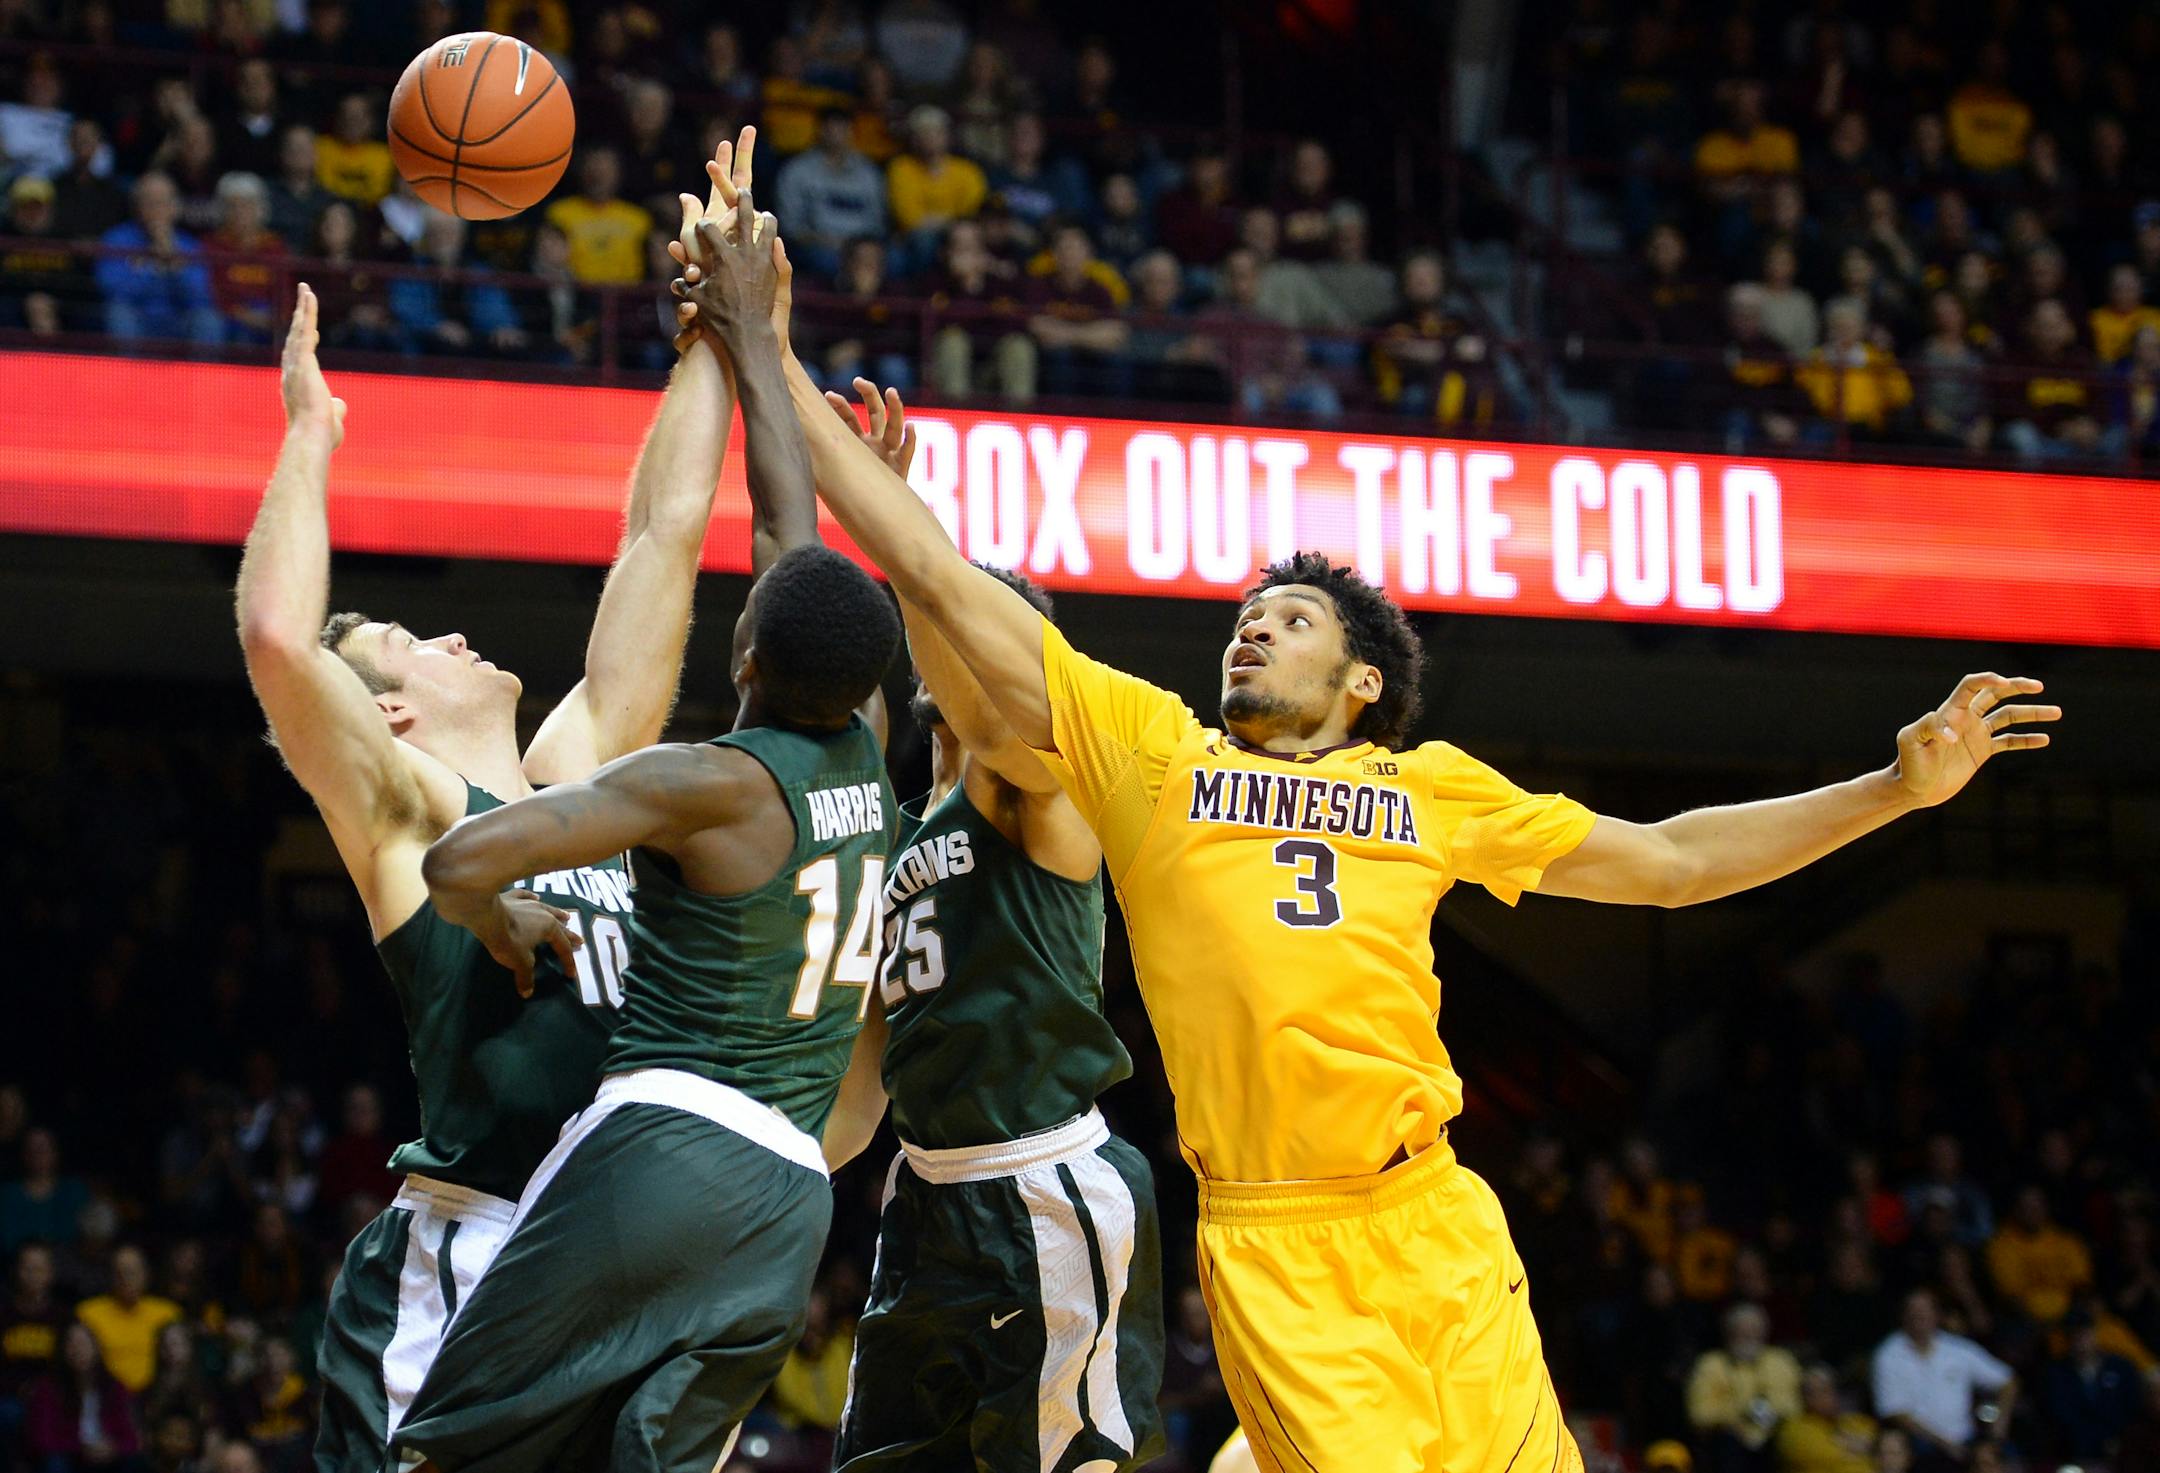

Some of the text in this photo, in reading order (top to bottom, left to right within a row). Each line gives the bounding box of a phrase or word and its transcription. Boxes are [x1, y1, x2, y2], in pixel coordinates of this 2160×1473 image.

[904, 416, 1785, 614] BOX OUT THE COLD
[805, 782, 884, 842] HARRIS
[1188, 767, 1421, 847] MINNESOTA
[1273, 836, 1344, 929] 3
[564, 908, 630, 1009] 10
[787, 854, 886, 1022] 14
[880, 896, 948, 1008] 25
